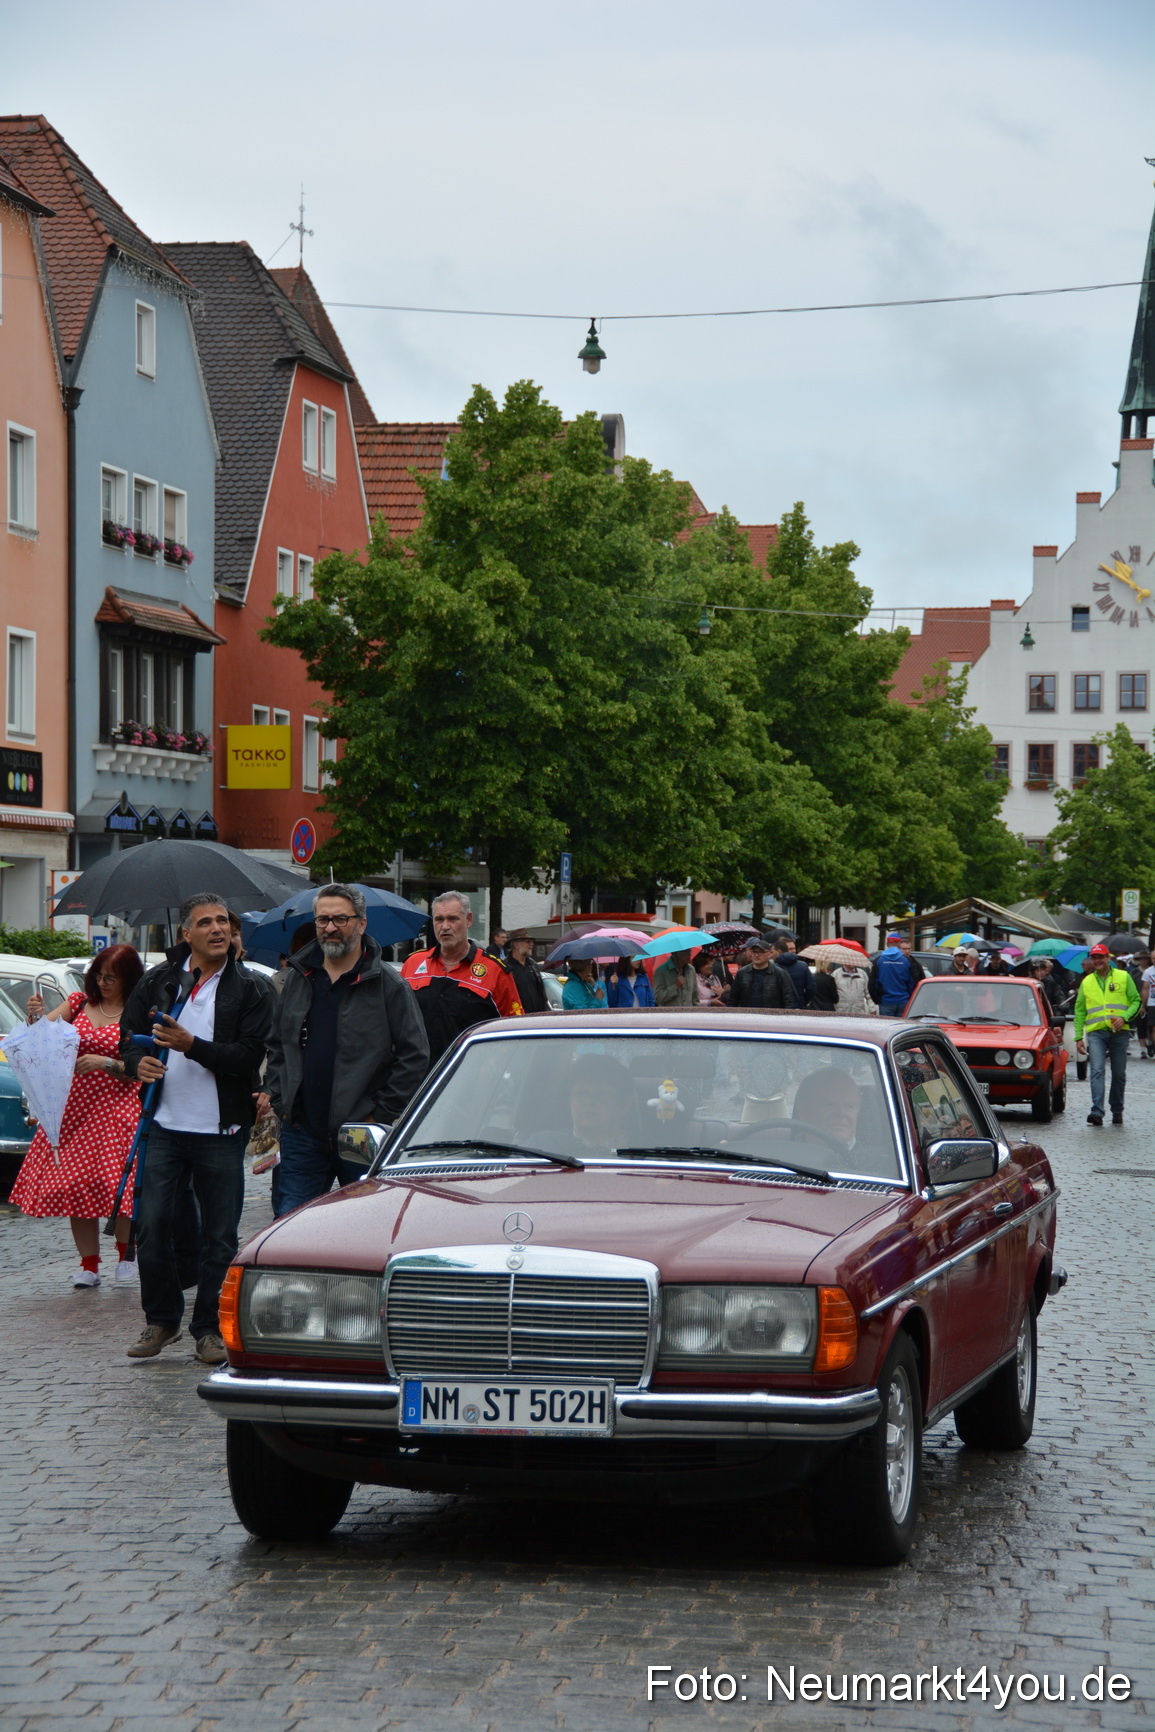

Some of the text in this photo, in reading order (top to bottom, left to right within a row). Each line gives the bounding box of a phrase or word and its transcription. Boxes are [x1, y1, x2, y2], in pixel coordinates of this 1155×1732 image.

[95, 939, 105, 953] P
[422, 1386, 606, 1423] NM ST 502H
[408, 1407, 416, 1417] D
